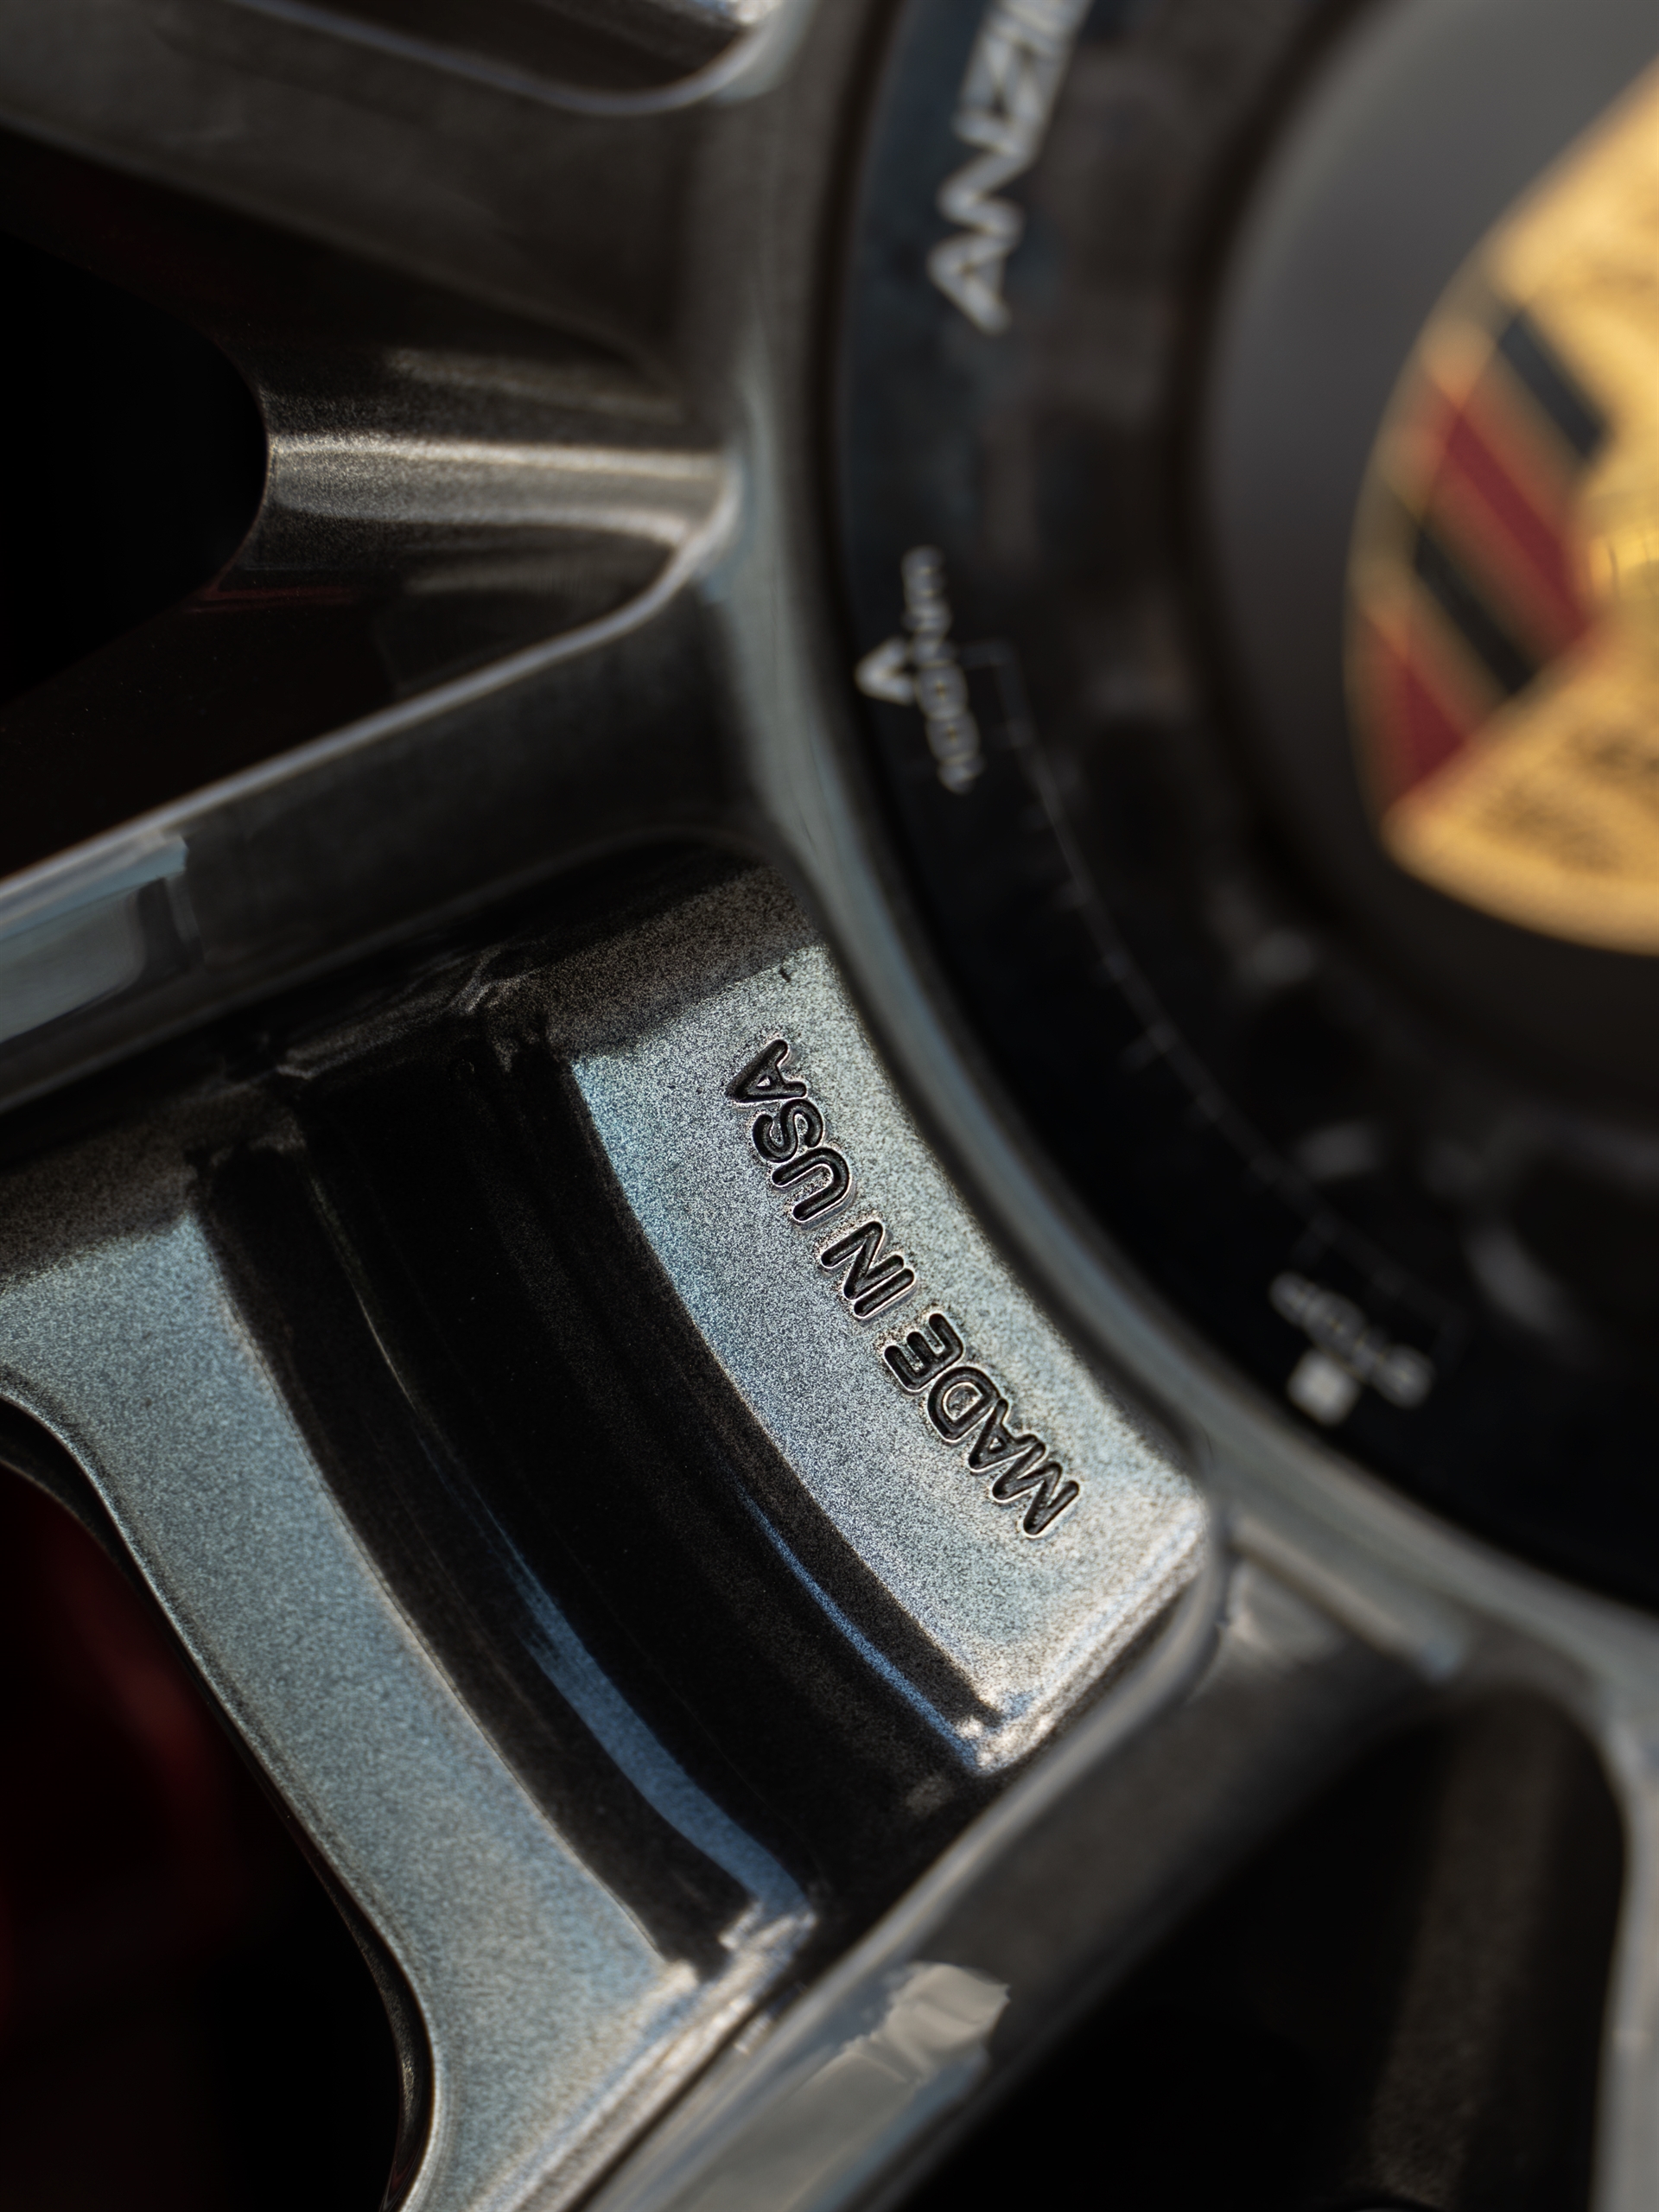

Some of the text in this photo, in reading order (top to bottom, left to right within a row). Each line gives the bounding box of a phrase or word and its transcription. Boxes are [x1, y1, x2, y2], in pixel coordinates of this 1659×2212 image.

[726, 1039, 1081, 1539] MADE IN USA
